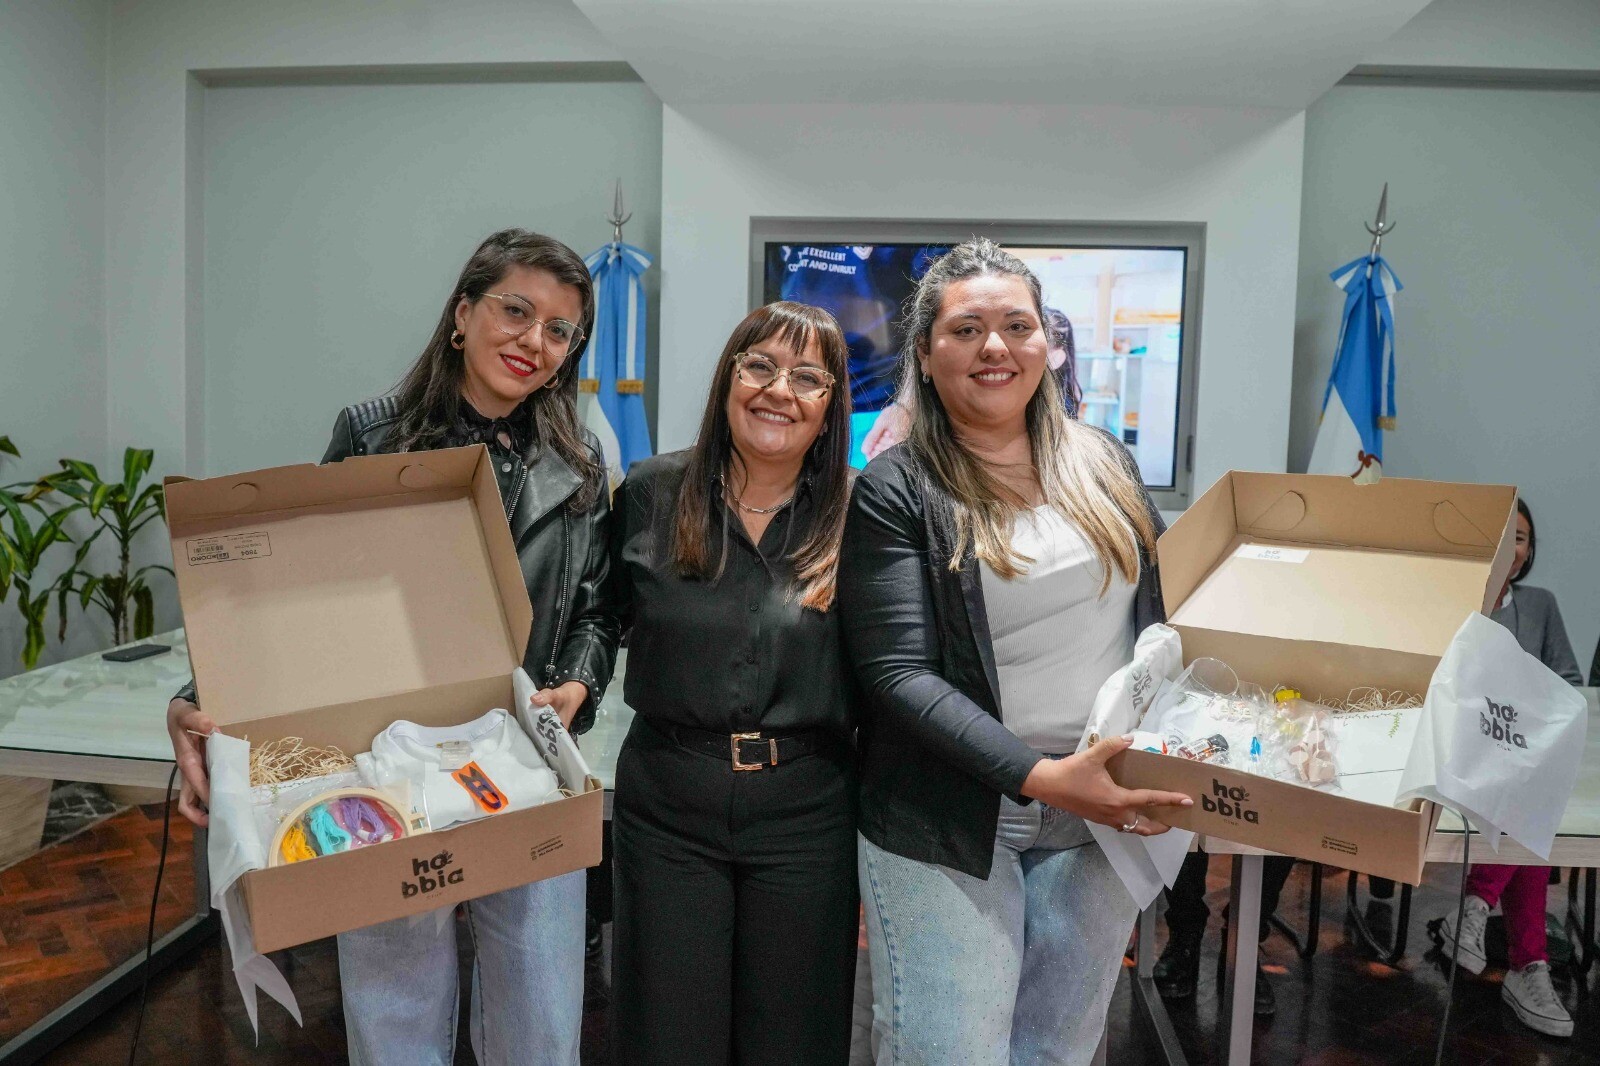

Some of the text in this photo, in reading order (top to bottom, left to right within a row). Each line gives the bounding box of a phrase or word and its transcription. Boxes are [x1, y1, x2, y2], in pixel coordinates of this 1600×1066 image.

[809, 260, 827, 272] AND
[829, 264, 856, 274] UNRULY
[810, 247, 845, 261] EXCELLENT
[1480, 711, 1528, 749] bbia
[1201, 793, 1259, 824] bbia
[402, 868, 464, 899] bbia
